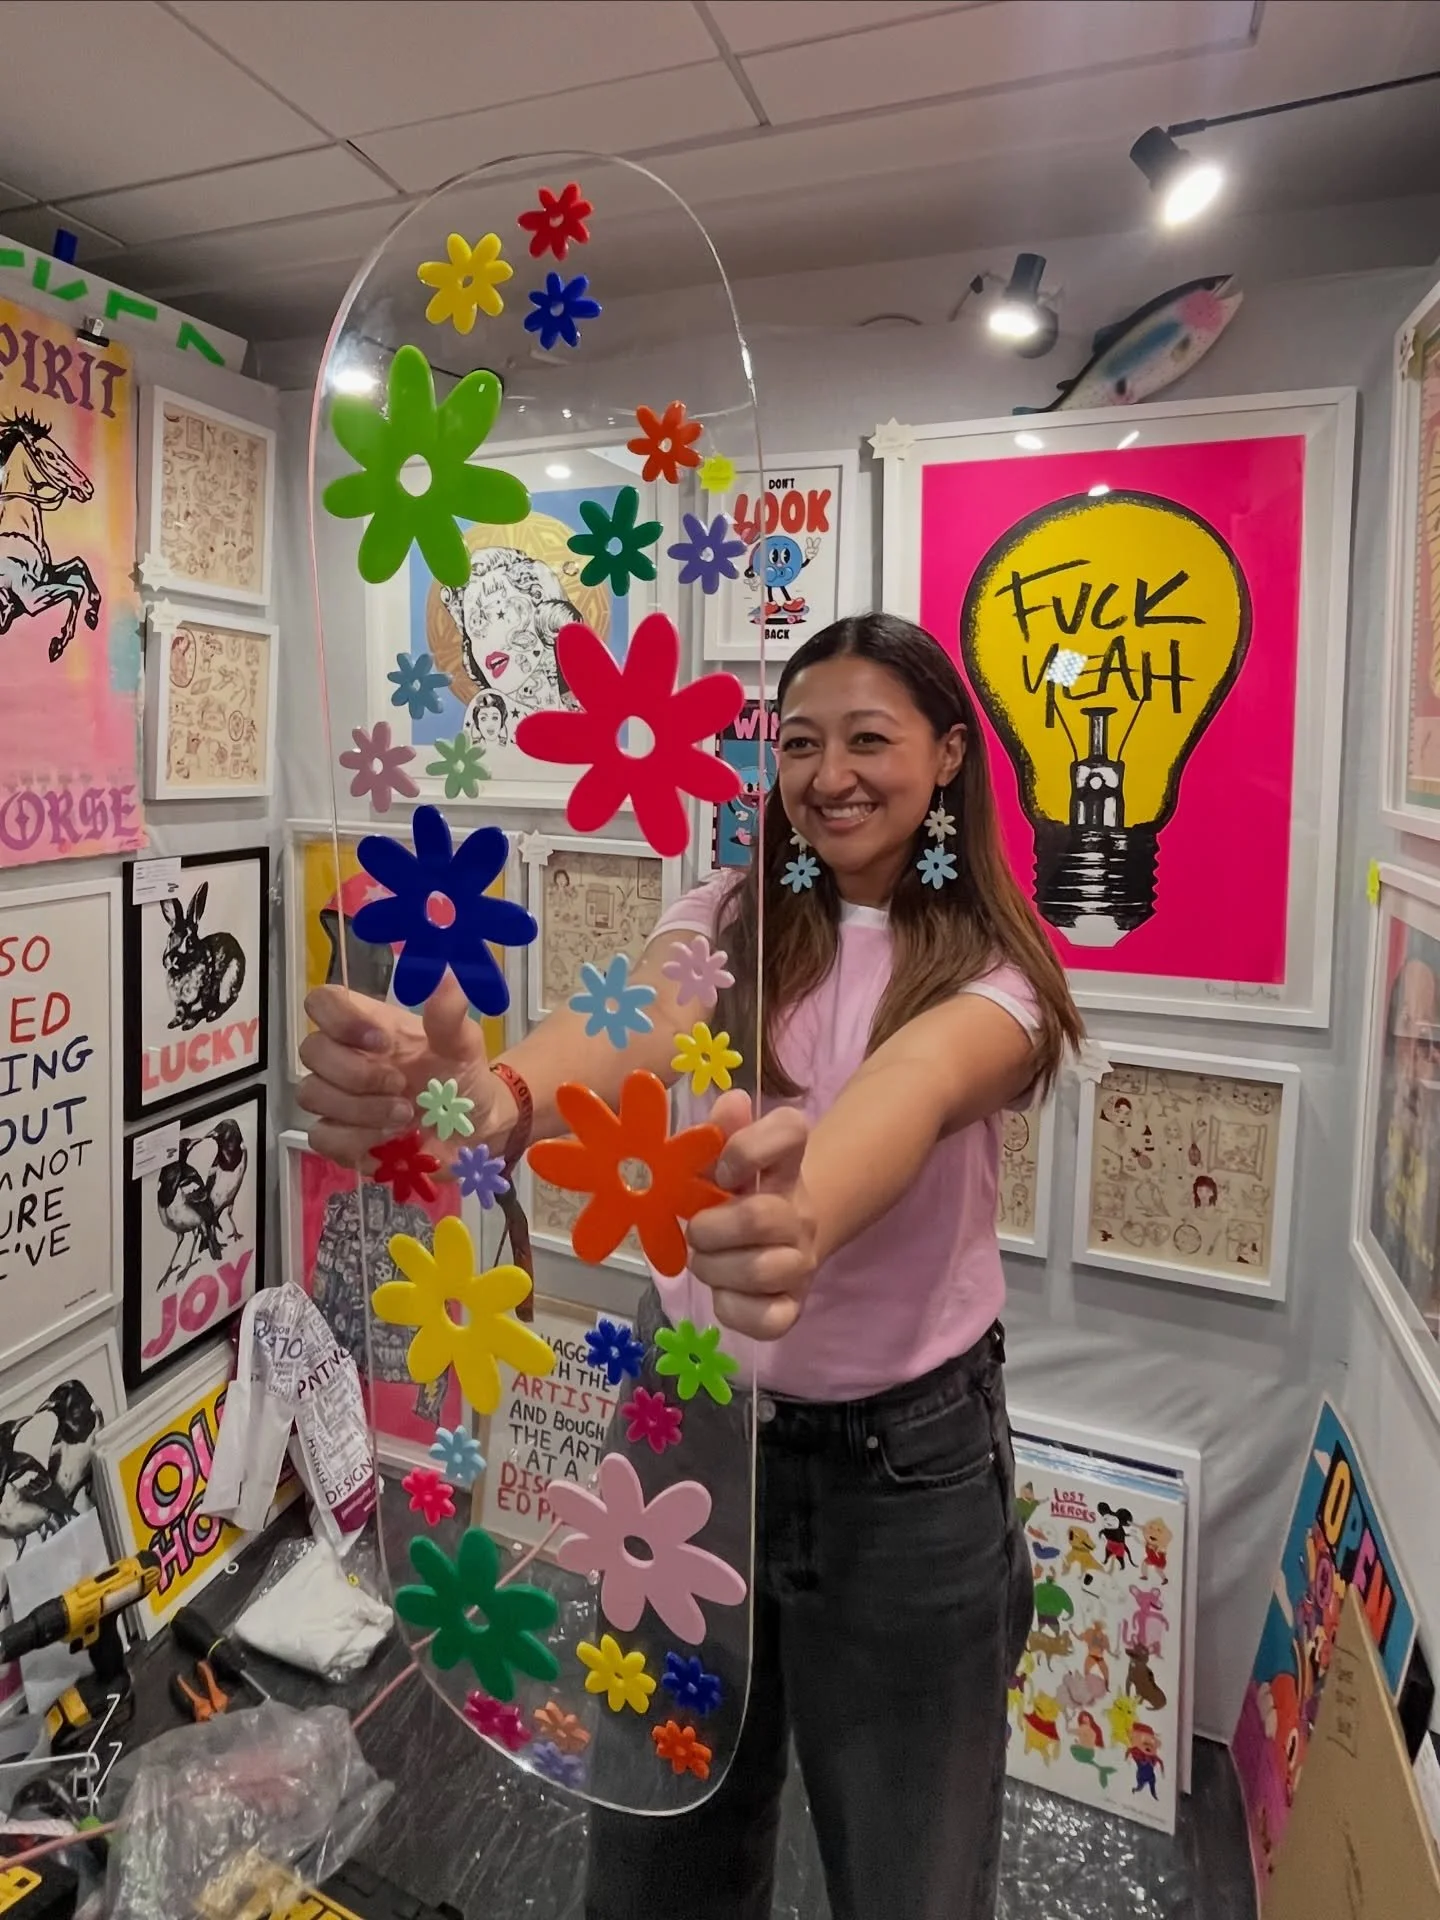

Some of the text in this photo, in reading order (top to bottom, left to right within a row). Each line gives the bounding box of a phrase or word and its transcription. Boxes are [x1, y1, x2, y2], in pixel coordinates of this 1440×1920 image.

[769, 478, 795, 490] DON'T
[733, 489, 831, 545] LOOK
[995, 559, 1207, 643] FUCK
[764, 629, 790, 640] BACK
[142, 1015, 260, 1091] LUCKY
[22, 1139, 93, 1187] NOT
[142, 1249, 255, 1359] JOY
[509, 1399, 547, 1425] AND
[511, 1371, 617, 1419] ARTIST
[509, 1423, 602, 1467] THE ART
[526, 1448, 578, 1482] AT A
[325, 1456, 375, 1506] DESIGN
[1053, 1487, 1088, 1507] LOST
